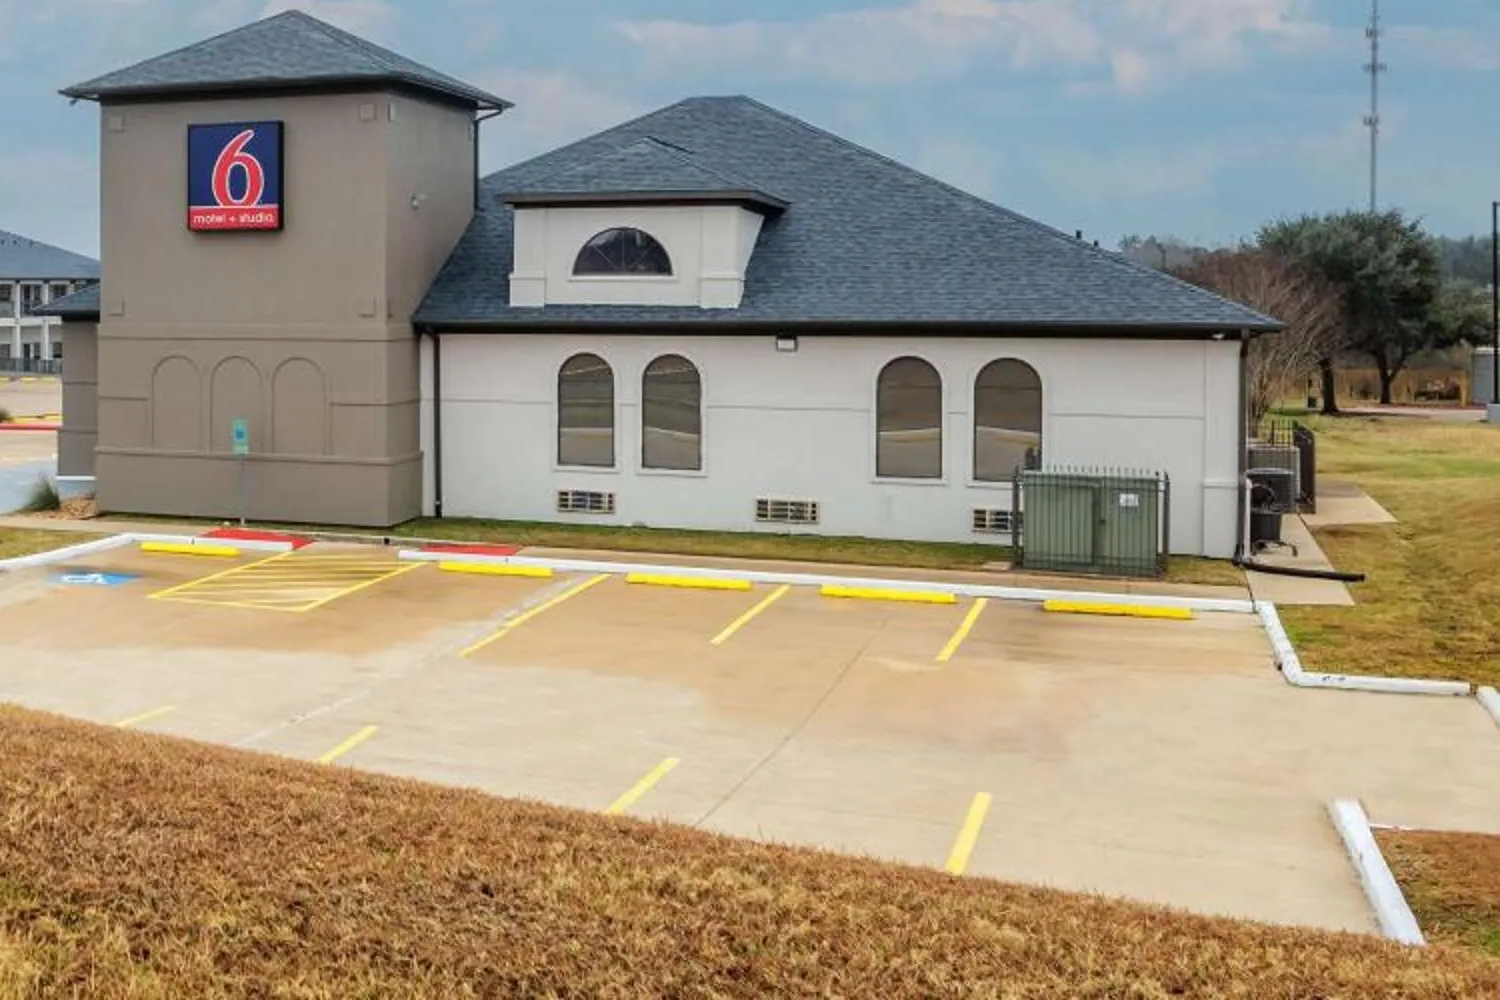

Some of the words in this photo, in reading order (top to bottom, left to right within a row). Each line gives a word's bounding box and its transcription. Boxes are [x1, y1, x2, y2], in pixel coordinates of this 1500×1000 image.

[211, 129, 265, 208] 6
[193, 213, 226, 224] motel
[239, 211, 275, 223] studio
